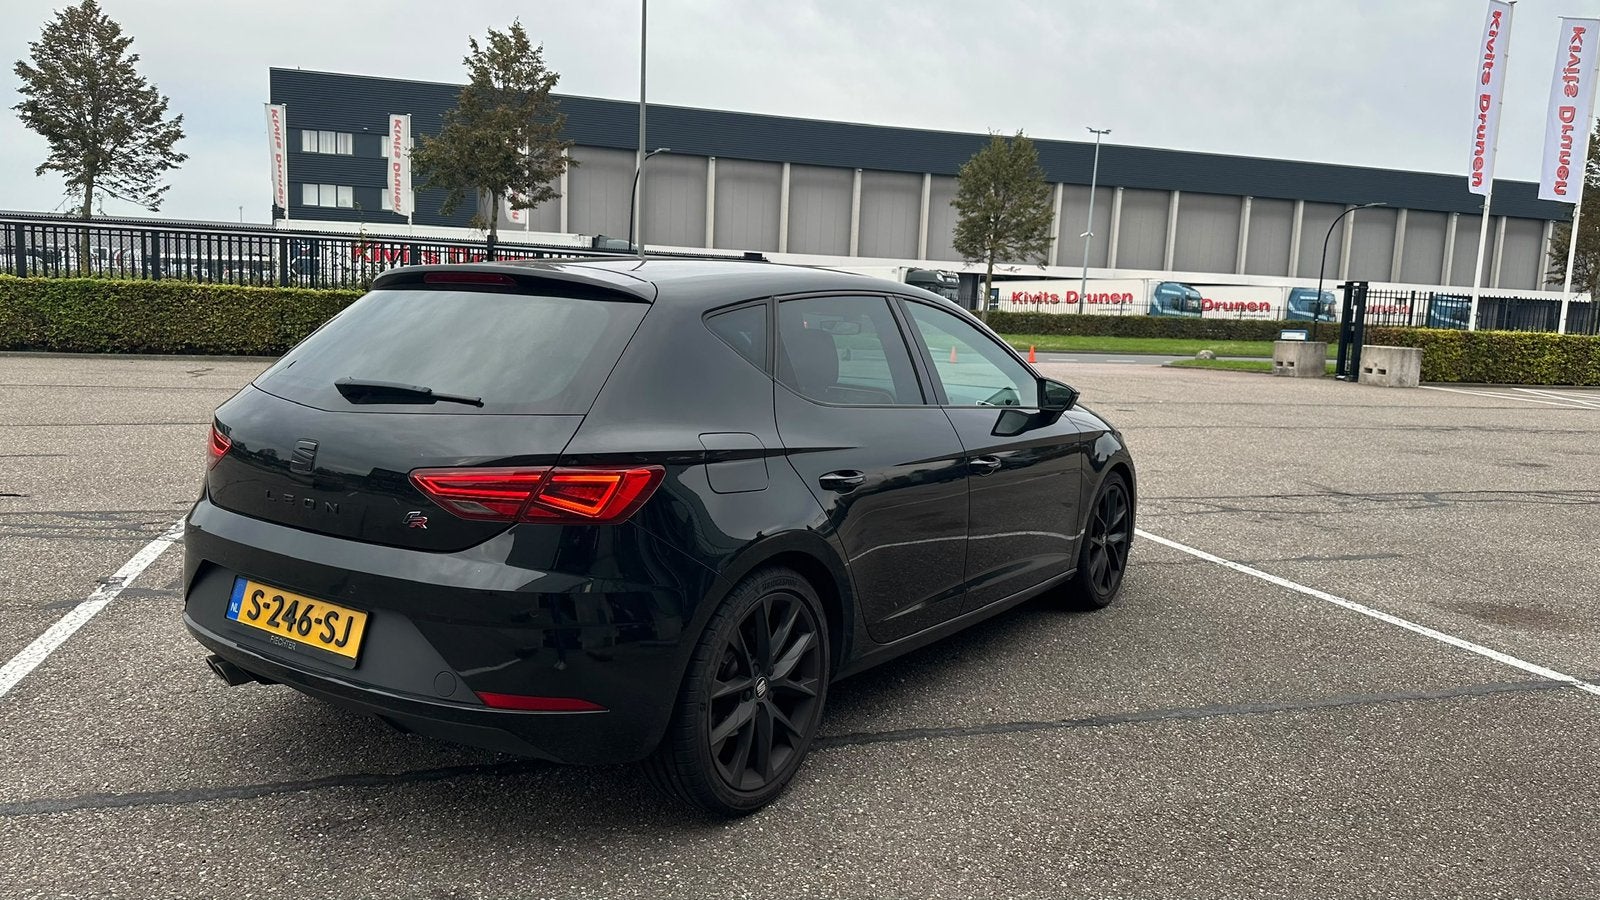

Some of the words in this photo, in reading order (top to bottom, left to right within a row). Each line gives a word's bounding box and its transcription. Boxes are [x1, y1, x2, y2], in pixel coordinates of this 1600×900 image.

[1480, 10, 1502, 86] Kivits
[1471, 93, 1492, 188] Drunen
[1011, 291, 1060, 305] Kivits
[1201, 298, 1271, 312] Drunen
[265, 489, 339, 514] LEON
[230, 602, 239, 614] NL
[246, 589, 354, 648] S-246-SJ
